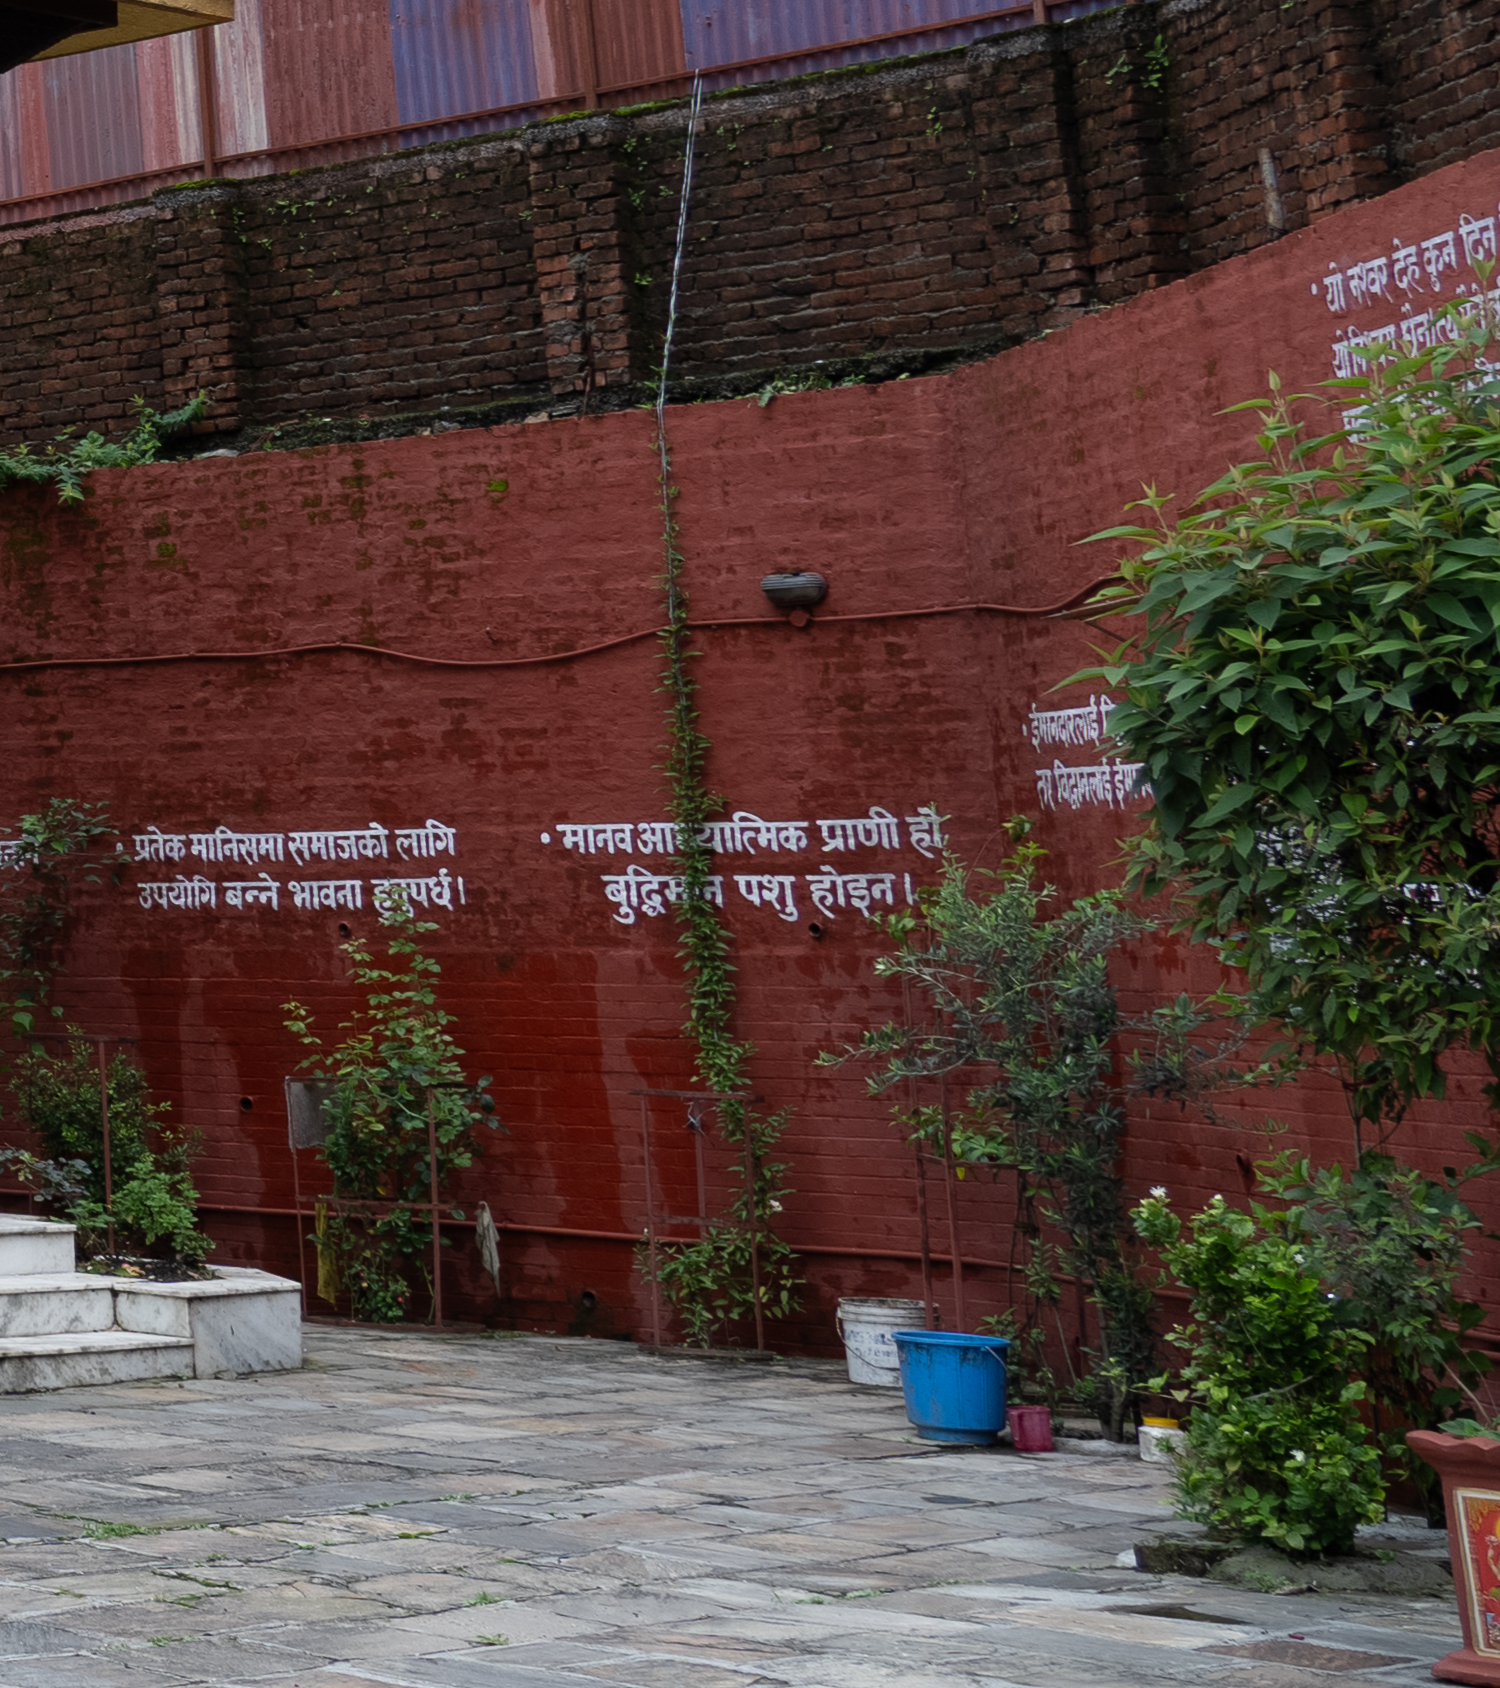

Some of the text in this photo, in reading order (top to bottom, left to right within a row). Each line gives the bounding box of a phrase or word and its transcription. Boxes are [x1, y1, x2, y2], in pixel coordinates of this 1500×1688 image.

[131, 818, 457, 867] प्रतेक मानिसमा समाजको लागि
[555, 822, 635, 855] मानव
[815, 805, 901, 852] प्राणी
[136, 874, 217, 910] उपयोगि
[221, 872, 282, 911] बन्ने
[287, 879, 364, 911] भावना
[733, 873, 799, 922] पशु
